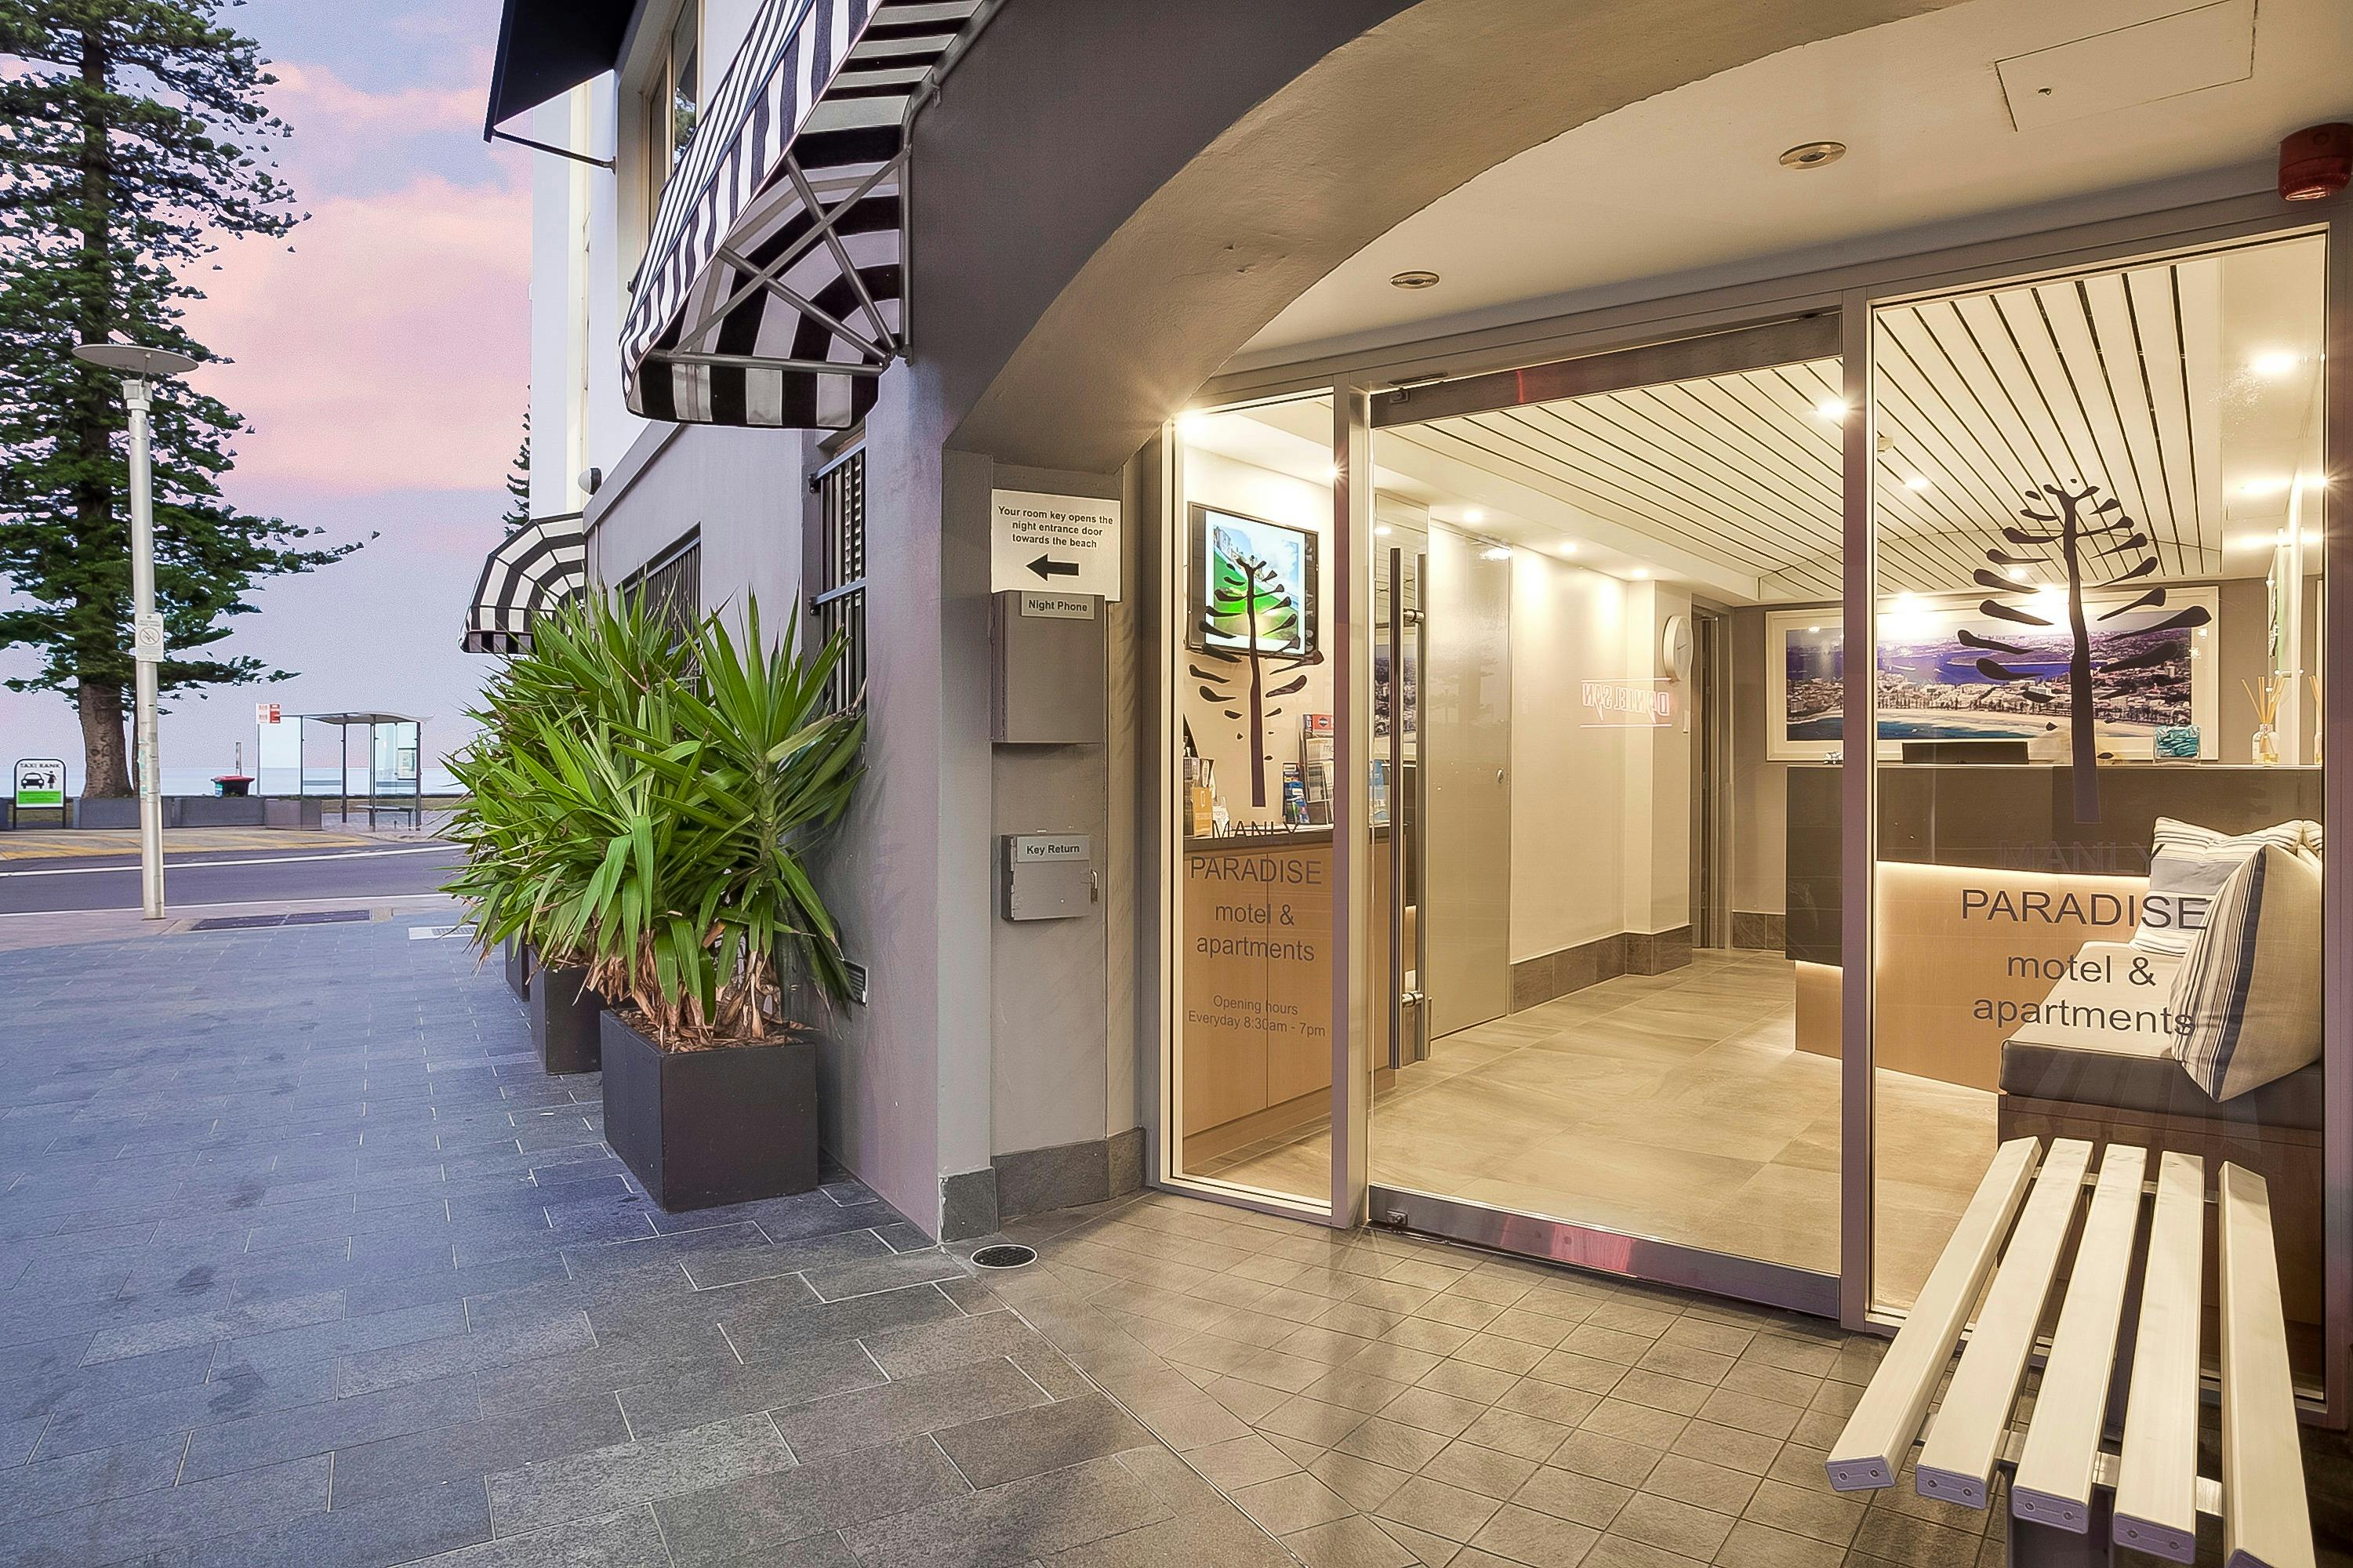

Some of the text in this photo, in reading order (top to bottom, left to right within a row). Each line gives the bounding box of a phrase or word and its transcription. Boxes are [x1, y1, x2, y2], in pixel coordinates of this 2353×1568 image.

[998, 506, 1113, 524] Your room key opens the
[1012, 521, 1103, 536] night entrance door
[1012, 533, 1097, 548] towards the beach
[1028, 599, 1088, 612] Night Phone
[1212, 820, 1298, 845] MANLY
[1026, 844, 1080, 855] Key Return
[2000, 840, 2165, 877] MANLY
[1191, 856, 1321, 884] PARADISE
[1215, 903, 1295, 926] motel &
[1962, 889, 2208, 930] PARADISE
[1196, 936, 1315, 961] apartments
[2007, 954, 2156, 987] motel &
[1213, 995, 1298, 1015] Opening hours
[1973, 998, 2195, 1036] apartments
[1188, 1010, 1240, 1029] Everyday
[1244, 1016, 1287, 1033] 8:30am
[1299, 1022, 1326, 1037] 7pm
